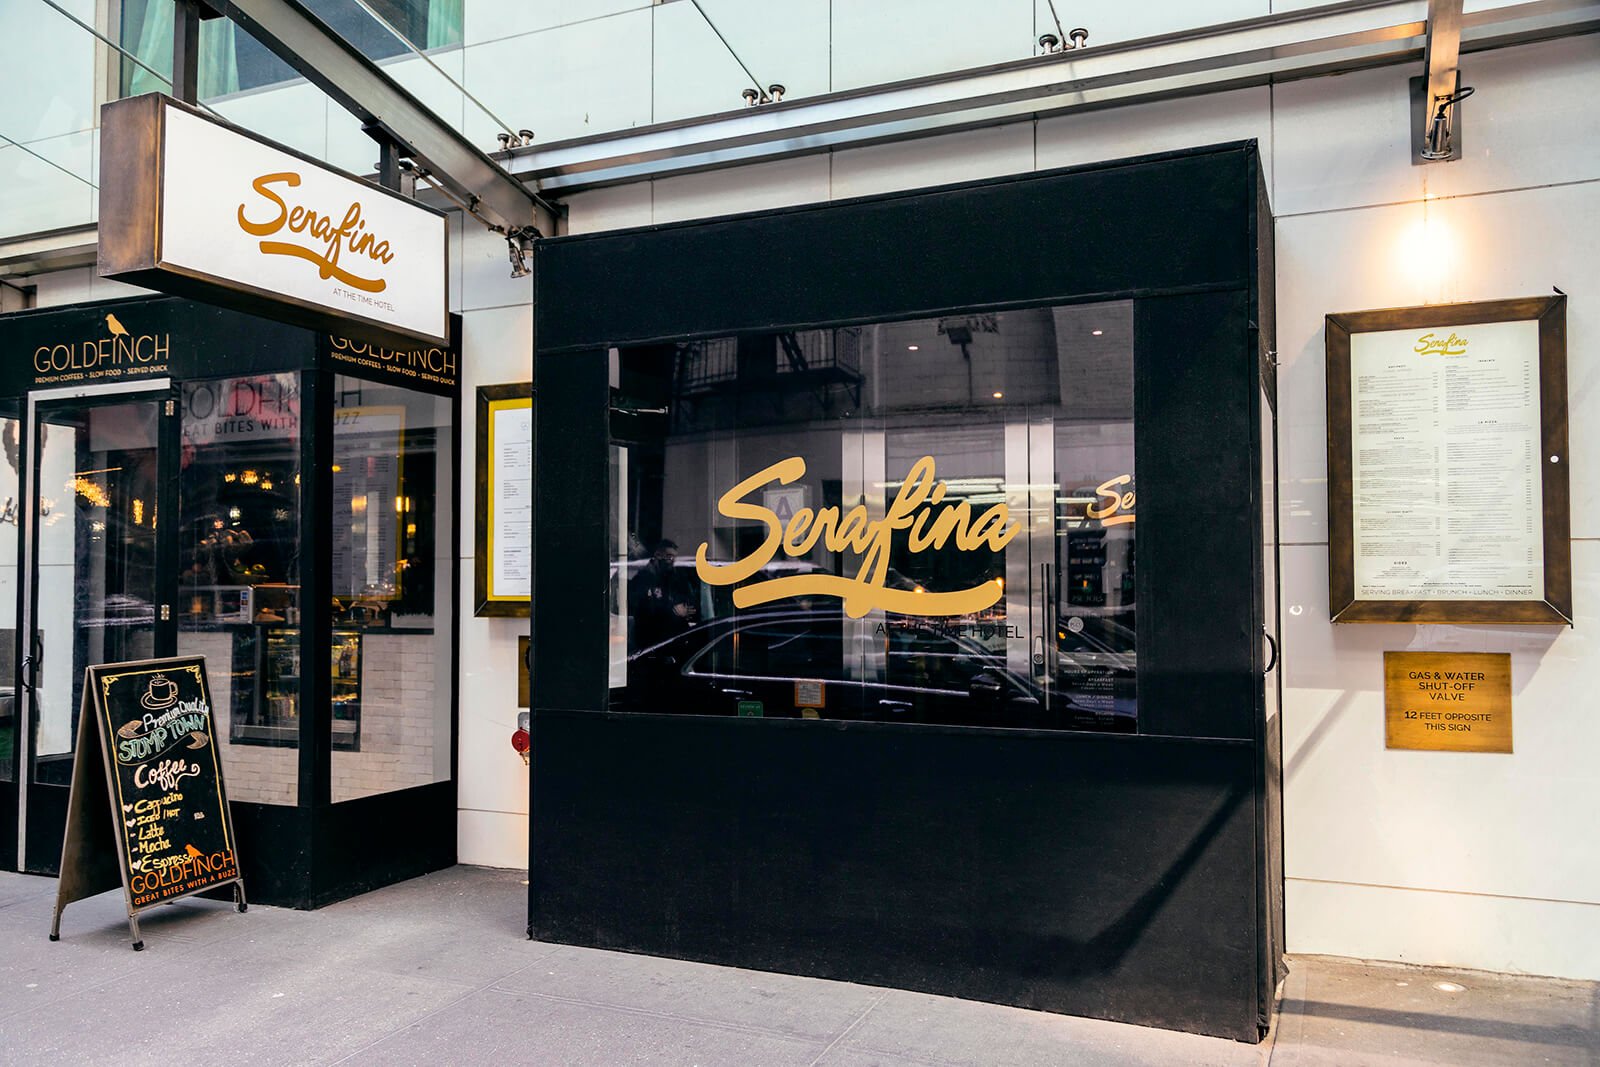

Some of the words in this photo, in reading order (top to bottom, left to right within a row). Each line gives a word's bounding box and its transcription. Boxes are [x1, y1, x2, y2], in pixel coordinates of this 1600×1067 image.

[238, 172, 394, 288] Serafina
[333, 288, 342, 296] AT
[343, 290, 356, 301] THE
[358, 294, 372, 305] TIME
[374, 299, 395, 312] HOTEL
[34, 333, 170, 373] GOLDFINCH
[1414, 332, 1469, 355] Serafina
[35, 374, 59, 384] PREMIUM
[60, 372, 84, 382] COFFEES
[89, 370, 105, 378] SLOW
[105, 368, 122, 377] FOOD
[127, 366, 149, 375] SERVED
[149, 364, 168, 373] QUICK
[331, 352, 357, 363] PREMIUM
[357, 357, 381, 369] COFFEES
[386, 364, 401, 373] SLOW
[402, 368, 416, 377] FOOD
[421, 372, 439, 382] SERVED
[440, 376, 455, 385] QUICK
[215, 420, 254, 434] BITES
[261, 417, 297, 430] WITH
[696, 455, 1021, 618] Serafina
[972, 624, 1024, 639] HOTEL
[1409, 671, 1431, 680] GAS
[1433, 671, 1441, 680] &
[1444, 672, 1485, 681] WATER
[1419, 682, 1475, 691] SHUT-OFF
[1429, 692, 1465, 701] VALVE
[143, 707, 180, 731] Premium
[166, 714, 205, 740] TOWN
[1404, 711, 1417, 720] 12
[1419, 711, 1442, 720] FEET
[1445, 713, 1492, 721] OPPOSITE
[1425, 722, 1446, 731] THIS
[1448, 724, 1471, 732] SIGN
[134, 759, 188, 791] Coffee
[138, 823, 165, 840] Latte
[139, 837, 171, 854] Mocha
[131, 849, 234, 894] GOLDFINCH
[140, 853, 194, 877] Espresso
[135, 890, 160, 905] GREAT
[163, 883, 185, 897] BITES
[187, 877, 207, 889] WITH
[218, 868, 236, 880] BUZZ
